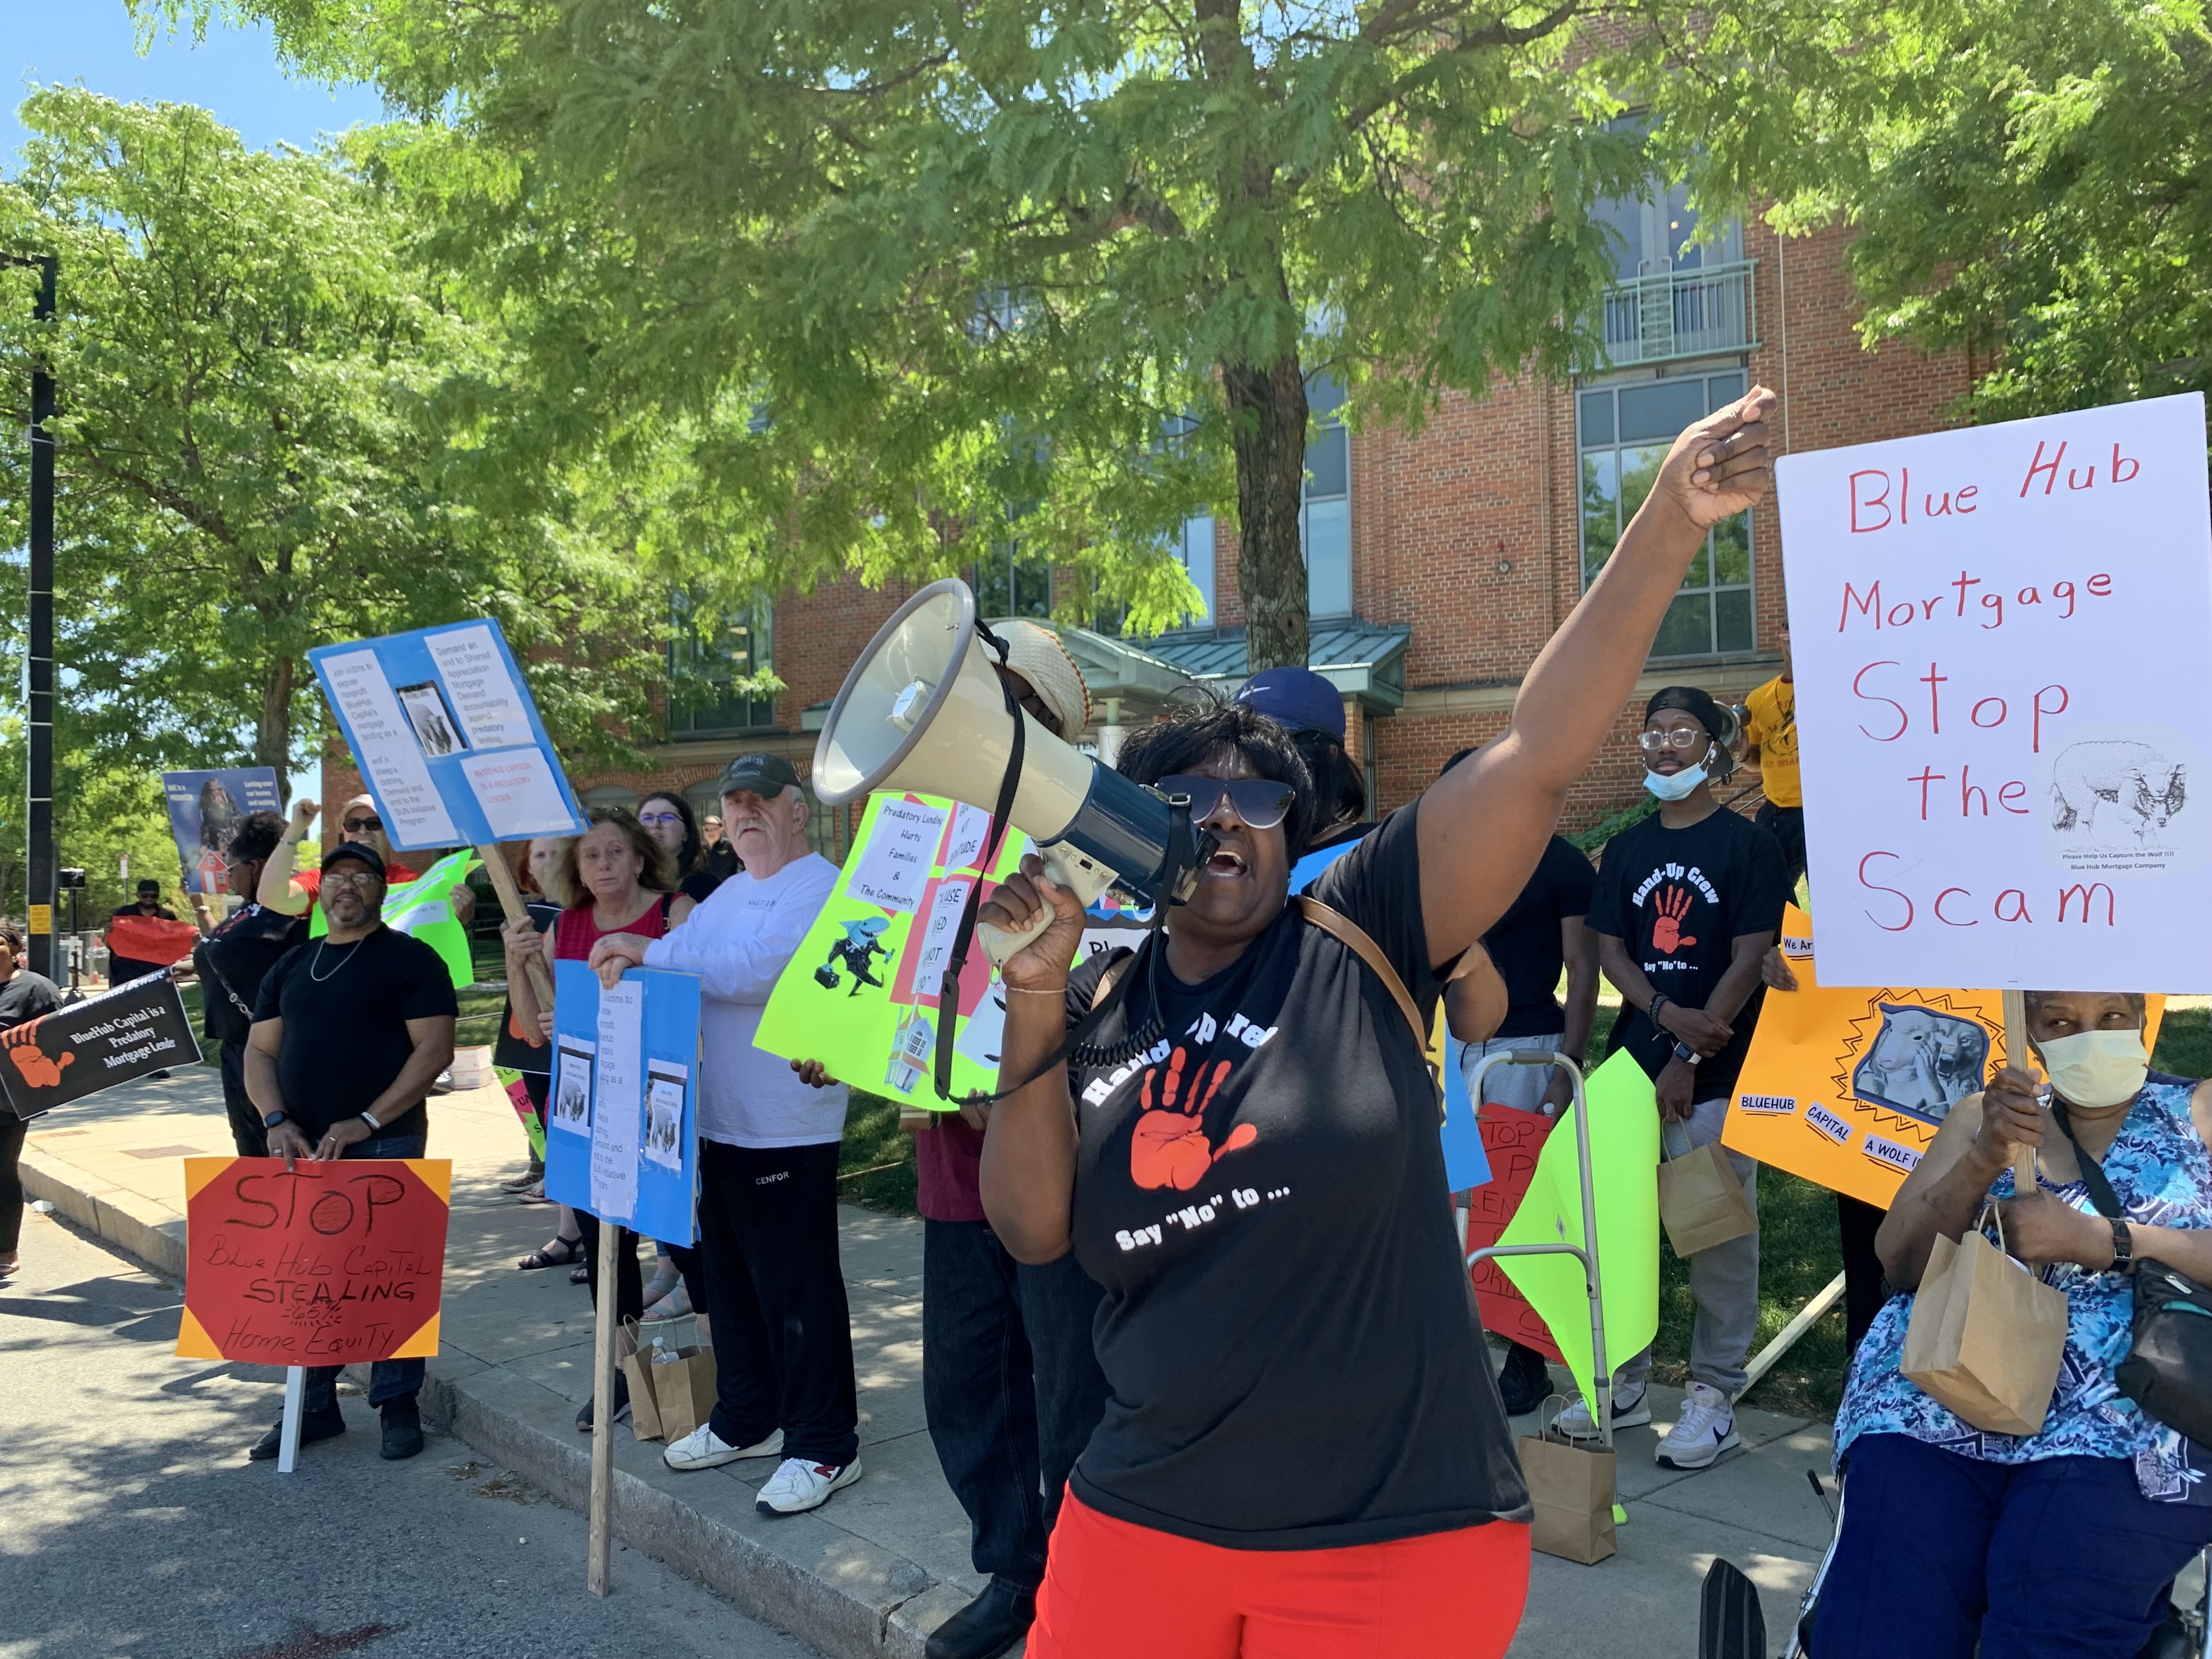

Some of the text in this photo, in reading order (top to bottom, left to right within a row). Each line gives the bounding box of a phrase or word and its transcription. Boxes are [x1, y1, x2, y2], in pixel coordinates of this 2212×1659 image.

[1849, 440, 2141, 533] Blue Hub
[1838, 570, 2113, 634] Mortgage
[436, 641, 478, 656] Demand an
[442, 658, 455, 667] end
[465, 651, 491, 663] Shared
[448, 664, 490, 678] Appreciation
[452, 678, 484, 690] Mortgage
[456, 689, 487, 701] Demand
[462, 698, 509, 712] accountability
[1852, 660, 2070, 753] Stop
[472, 724, 504, 735] predatory
[1907, 765, 2030, 820] the
[883, 805, 921, 825] Predatory
[922, 814, 943, 827] Lending
[901, 829, 921, 842] Hurts
[888, 848, 918, 863] Families
[893, 871, 900, 881] &
[1687, 866, 1720, 904] Crew
[861, 884, 915, 909] The Community
[1858, 851, 2115, 932] Scam
[1784, 936, 1813, 950] We Ar
[1644, 962, 1656, 973] Say
[625, 995, 633, 1004] to
[70, 1006, 166, 1044] BlueHub Capital is a
[108, 1026, 156, 1048] Predatory
[103, 1037, 176, 1068] Mortgage Lender
[1741, 1096, 1795, 1110] BLUEHUB
[1808, 1106, 1849, 1141] CAPITAL
[611, 1144, 623, 1153] and
[1865, 1140, 1874, 1151] A
[1879, 1143, 1910, 1164] WOLF
[755, 1171, 789, 1185] CENFOR
[225, 1172, 405, 1237] STOP
[1115, 1223, 1163, 1251] Say
[1165, 1194, 1223, 1229] "No"
[1232, 1187, 1260, 1209] to
[274, 1242, 332, 1277] Hub
[242, 1279, 415, 1304] STEALING
[223, 1317, 296, 1352] Home
